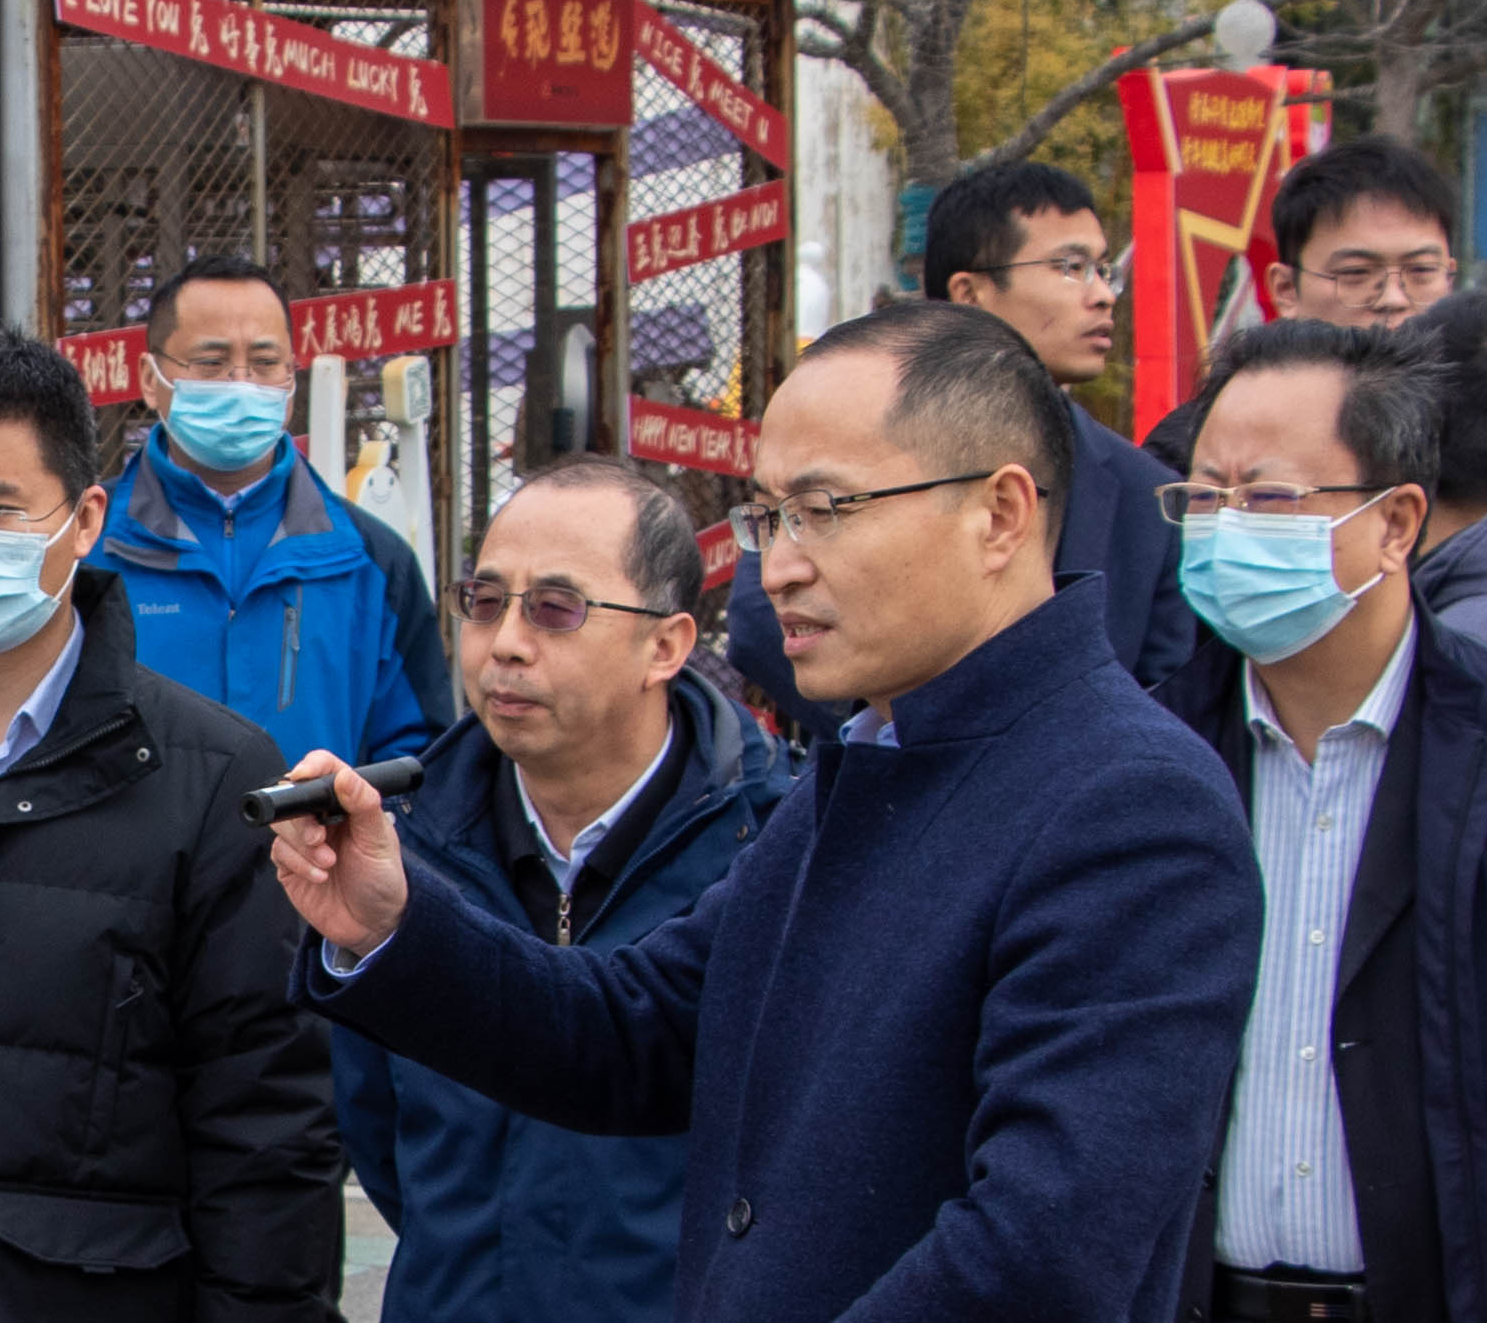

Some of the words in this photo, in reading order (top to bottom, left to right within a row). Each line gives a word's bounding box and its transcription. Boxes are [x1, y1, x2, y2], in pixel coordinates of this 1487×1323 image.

[283, 39, 336, 82] MUCH
[346, 57, 400, 102] LUCKY
[408, 62, 428, 118] 兔
[639, 25, 684, 76] NICE
[708, 81, 753, 130] MEET
[394, 301, 423, 337] ME
[431, 285, 453, 338] 兔
[633, 418, 667, 449] HAPPY
[669, 424, 697, 456] NEW
[697, 427, 733, 458] YEAR
